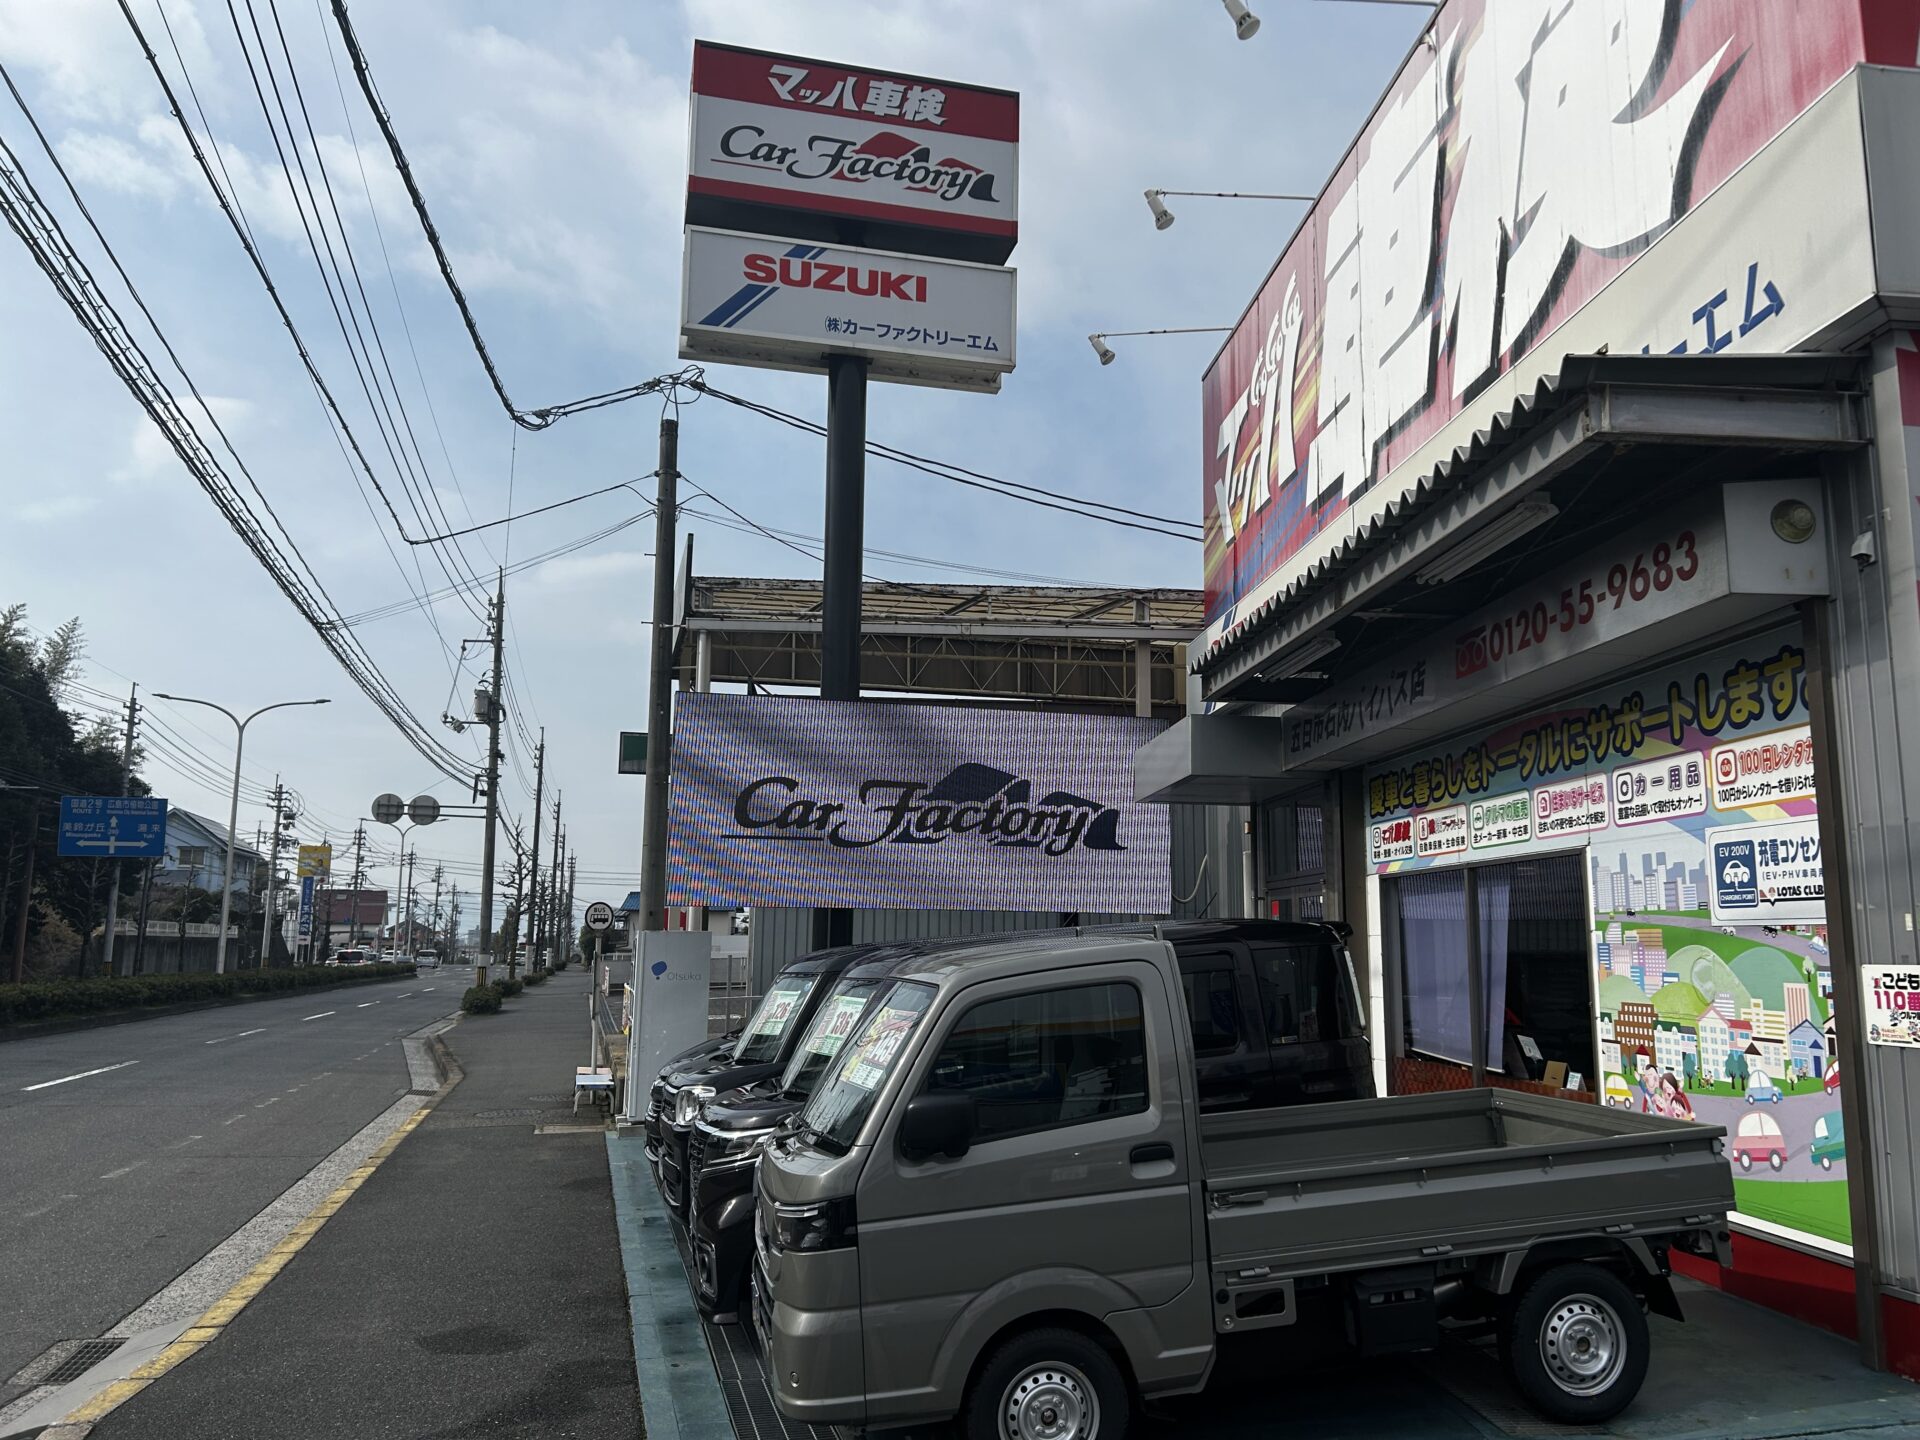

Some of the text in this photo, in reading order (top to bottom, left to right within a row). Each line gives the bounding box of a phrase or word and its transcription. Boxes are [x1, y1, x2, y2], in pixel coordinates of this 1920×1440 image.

[767, 63, 949, 126] マッハ車検
[719, 125, 973, 202] Car Factory
[743, 253, 928, 303] SUZUKI
[1487, 529, 1699, 662] 0120-55-9683
[1634, 761, 1701, 797] カー用品
[733, 776, 1091, 858] Car Factory
[1720, 844, 1750, 857] EV 200V
[1758, 836, 1820, 867] 充電コンセン
[1777, 884, 1824, 897] LOTAS CLUB
[667, 971, 702, 982] Otsuka
